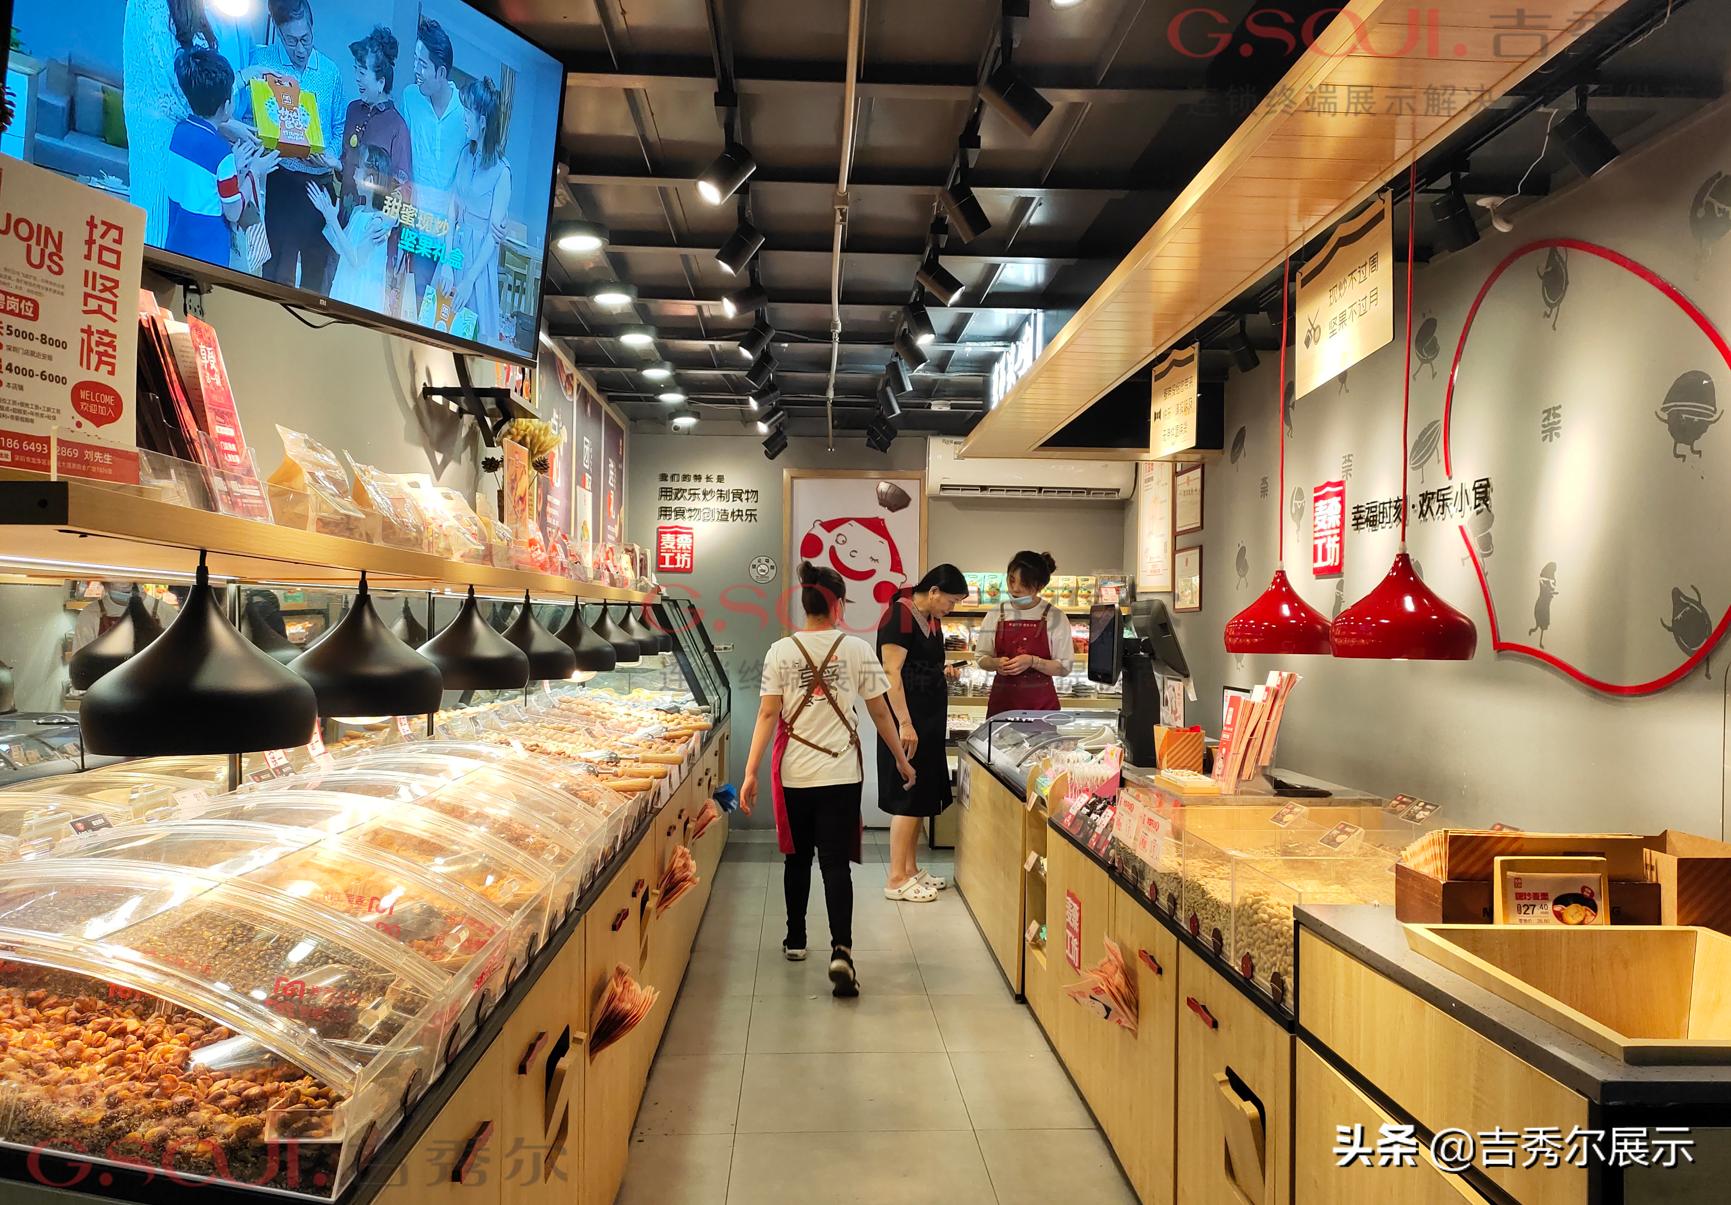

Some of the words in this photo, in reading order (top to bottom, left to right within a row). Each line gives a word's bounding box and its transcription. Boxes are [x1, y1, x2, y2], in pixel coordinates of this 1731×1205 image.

[0, 212, 63, 254] JOIN
[26, 243, 64, 276] US
[398, 228, 464, 270] 坚果礼盒
[1328, 251, 1379, 309] 现炒不过周
[79, 214, 124, 378] 招贤榜
[1328, 286, 1379, 340] 坚果不过月
[6, 324, 68, 350] 5000-8000
[5, 362, 68, 386] 4000-6000
[79, 389, 116, 406] WELCOME
[79, 401, 116, 418] 欢迎加入
[22, 441, 49, 454] 6493
[83, 449, 113, 465] 刘先生
[658, 472, 725, 484] 我们的特长是
[658, 486, 759, 503] 用欢乐炒制食物
[657, 506, 758, 522] 用食物创造快乐
[660, 533, 692, 549] 麦栗
[1314, 536, 1340, 568] 工坊
[660, 552, 691, 568] 工坊
